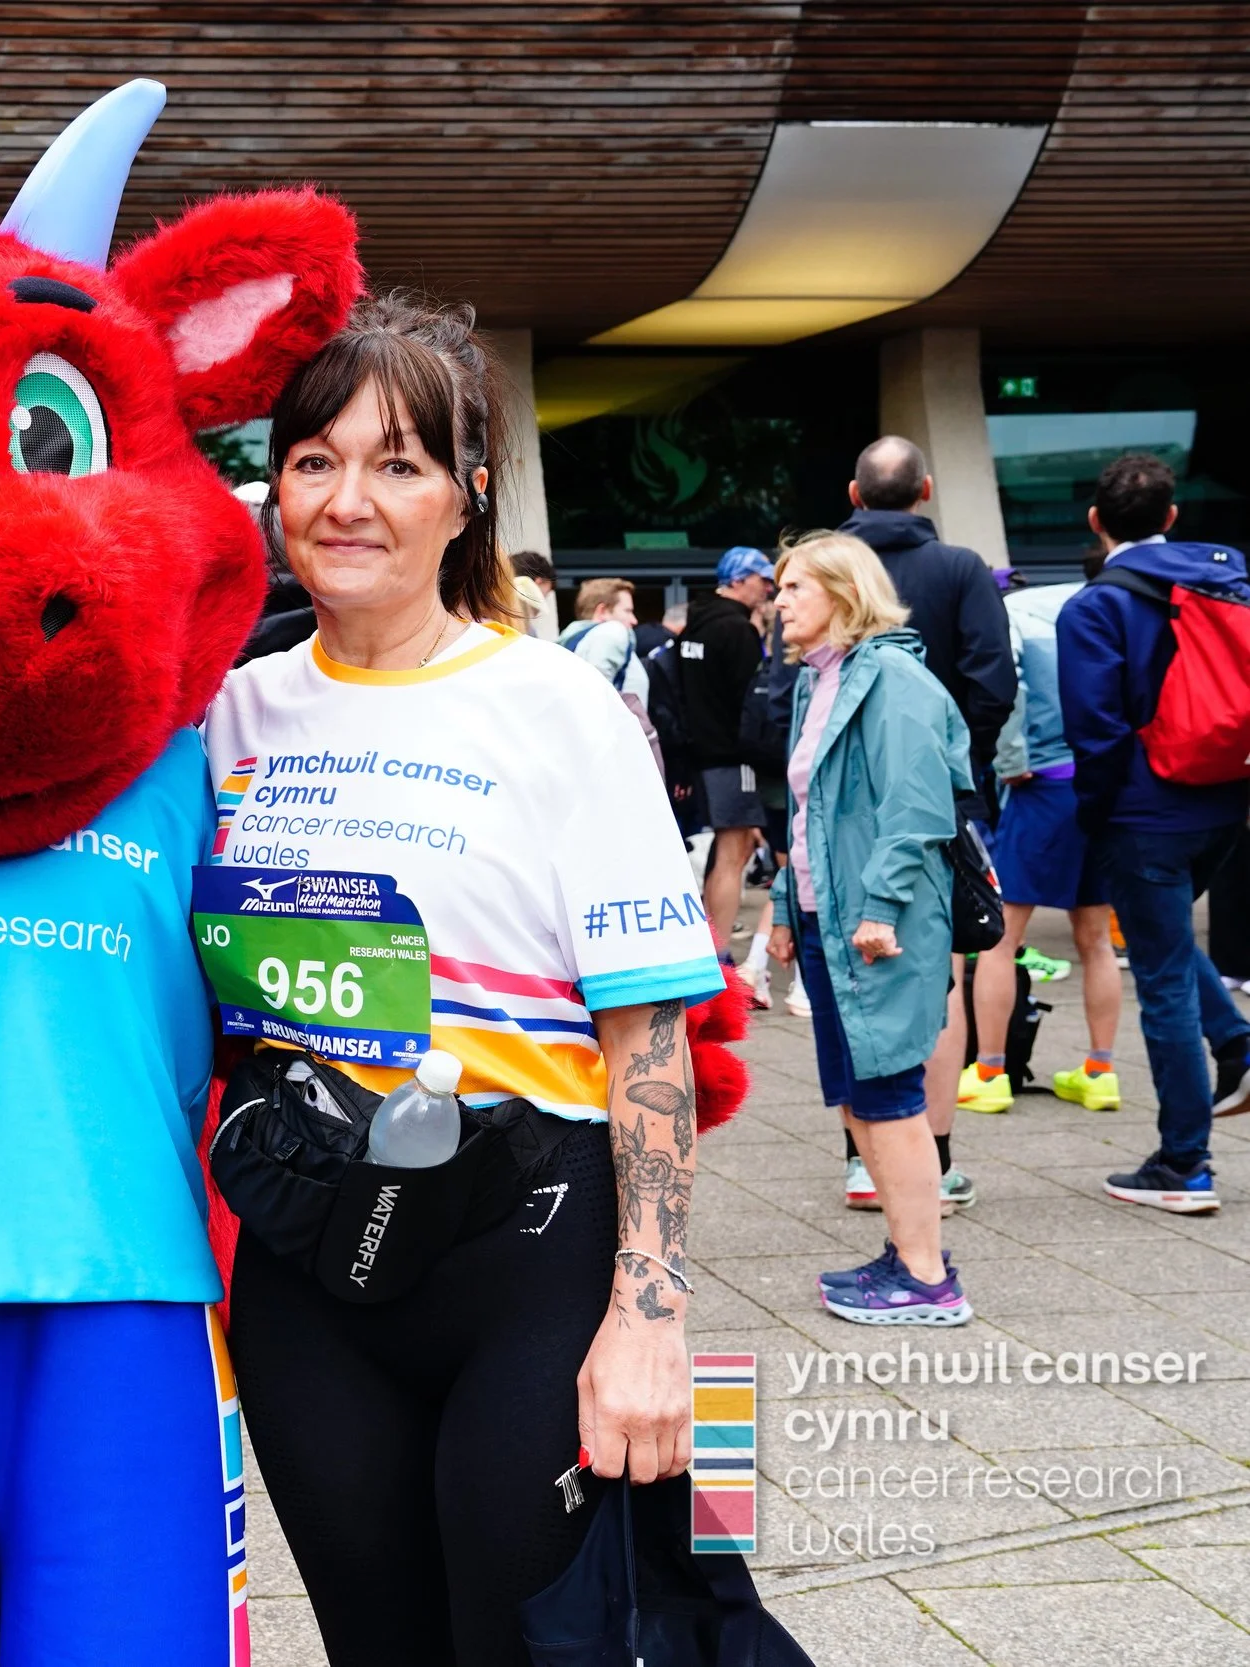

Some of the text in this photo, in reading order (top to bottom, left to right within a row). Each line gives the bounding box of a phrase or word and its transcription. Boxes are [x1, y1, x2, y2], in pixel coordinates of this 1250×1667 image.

[264, 750, 498, 797] ymchwil canser
[254, 784, 337, 808] cymru
[241, 813, 467, 855] cancer research
[233, 841, 310, 869] wales
[302, 876, 380, 896] SWANSEA
[240, 898, 295, 913] MIZUNO
[322, 908, 354, 916] MARATHON
[201, 924, 230, 947] JO
[391, 935, 425, 947] CANCER
[350, 946, 427, 961] RESEARCH WALES
[257, 957, 364, 1018] 956
[262, 1019, 382, 1060] #RUNSWANSEA
[349, 1185, 401, 1288] WATERFLY
